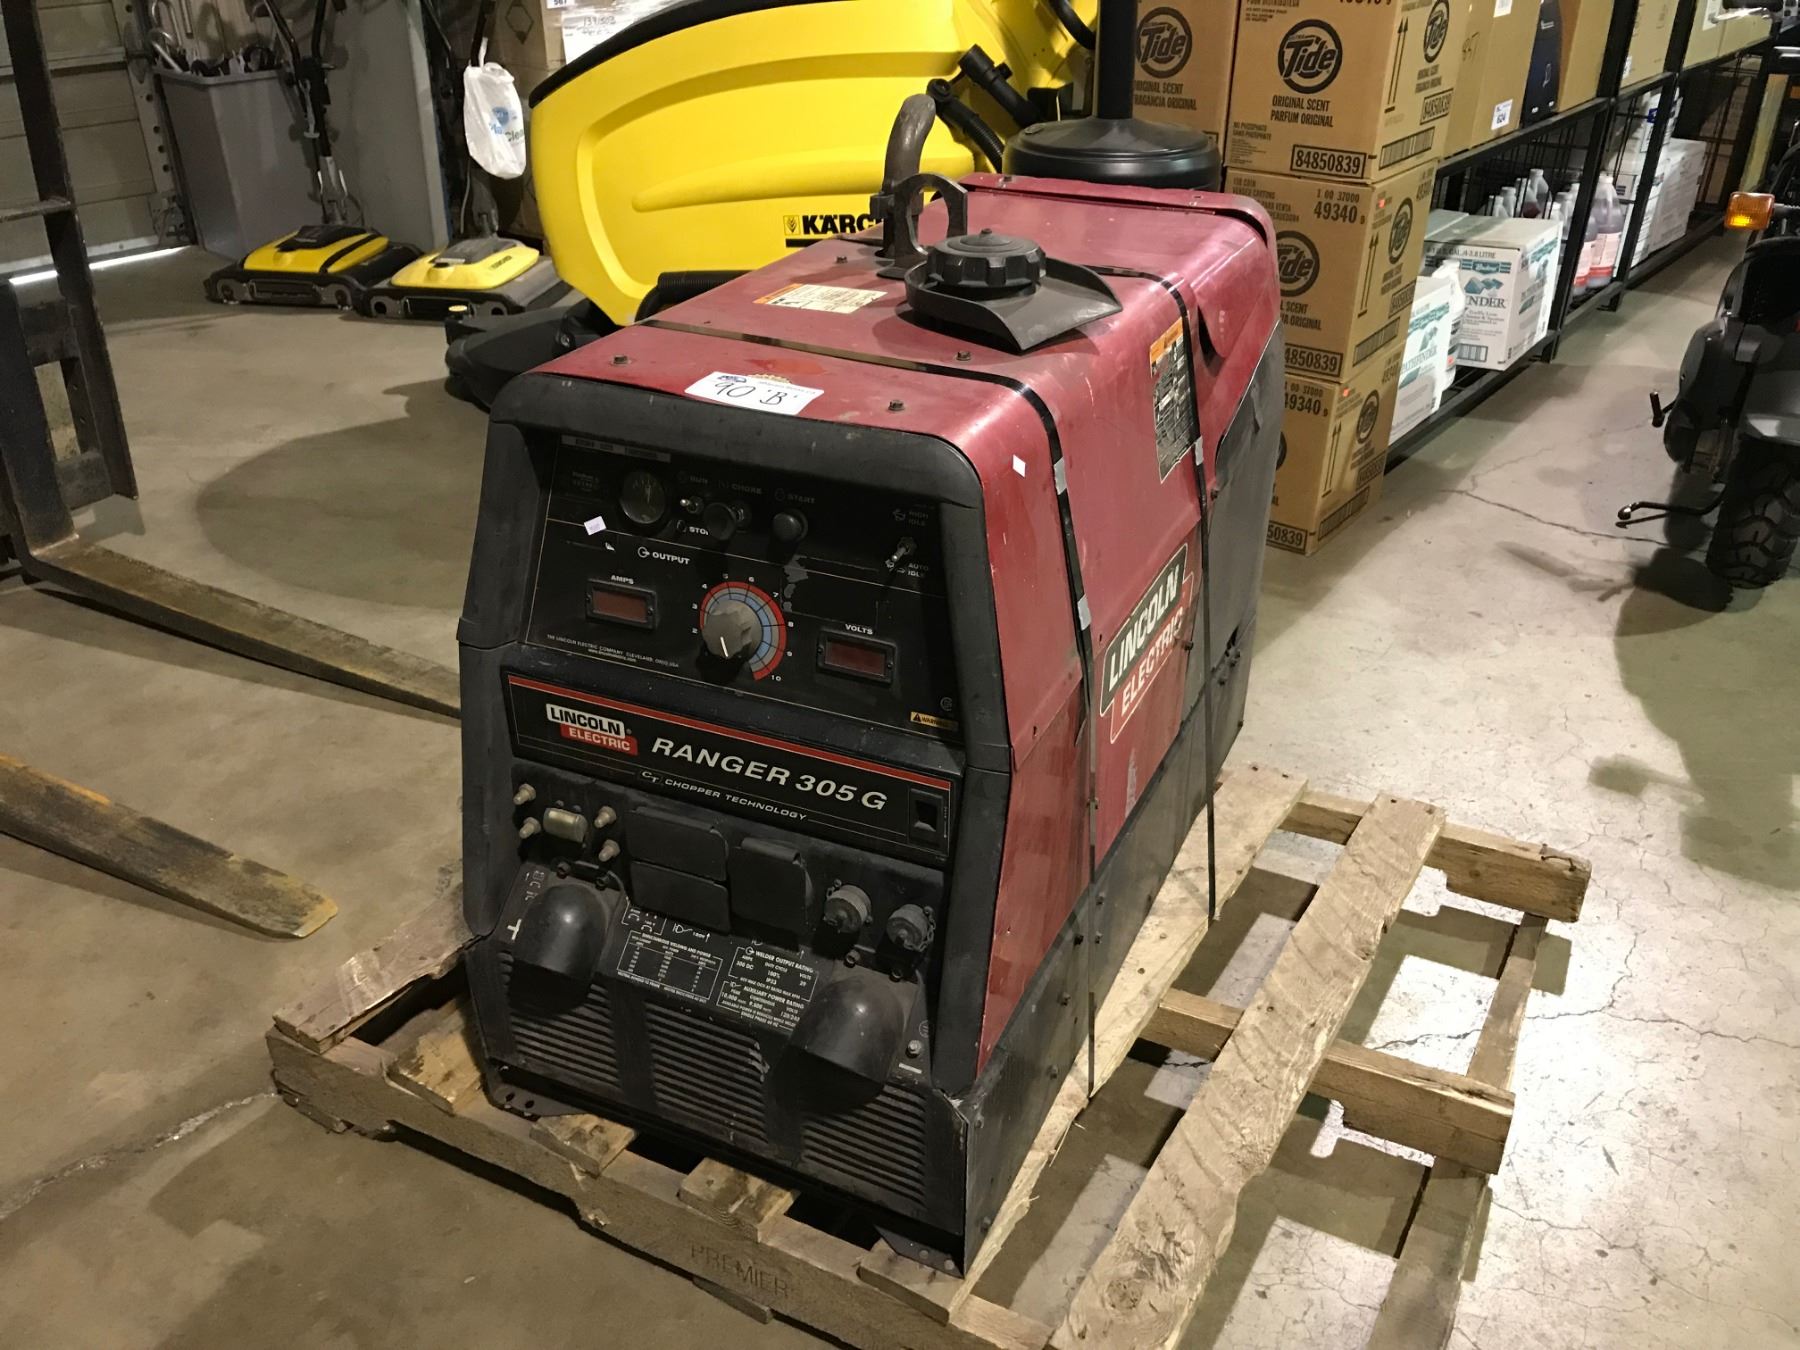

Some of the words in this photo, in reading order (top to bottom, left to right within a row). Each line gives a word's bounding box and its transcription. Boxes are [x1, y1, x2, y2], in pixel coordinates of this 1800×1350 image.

[1140, 23, 1186, 64] Tide
[1283, 36, 1337, 78] Tide
[1162, 82, 1184, 94] SCENT
[1167, 98, 1197, 110] ORIGINAL
[1272, 95, 1305, 110] ORIGINAL
[1306, 98, 1330, 112] SCENT
[1270, 110, 1300, 123] PARFUM
[1300, 113, 1333, 128] ORIGINAL
[1296, 150, 1360, 174] 84850839
[1337, 192, 1360, 203] 37000
[1314, 201, 1358, 224] 49340
[802, 213, 882, 234] KÄRC
[1286, 302, 1308, 314] SCENT
[1290, 315, 1322, 330] ORIGINAL
[1285, 347, 1338, 372] 4850839
[731, 483, 763, 494] CHOKE
[786, 492, 816, 504] START
[652, 552, 690, 565] OUTPUT
[610, 574, 634, 584] AMPS
[844, 624, 873, 635] VOLTS
[1109, 564, 1180, 692] LINCOLN
[1121, 606, 1184, 716] ELECTRIC
[771, 674, 782, 682] 10
[550, 707, 620, 736] LINCOLN
[569, 727, 630, 751] ELECTRIC
[651, 737, 791, 786] RANGER
[794, 774, 858, 802] 305
[860, 790, 888, 811] G
[664, 779, 721, 798] CHOPPER
[725, 794, 808, 821] TECHNOLOGY
[756, 950, 775, 961] WELDER
[776, 958, 794, 968] OUTPUT
[768, 993, 786, 1003] POWER
[690, 1243, 788, 1298] PREMIER
